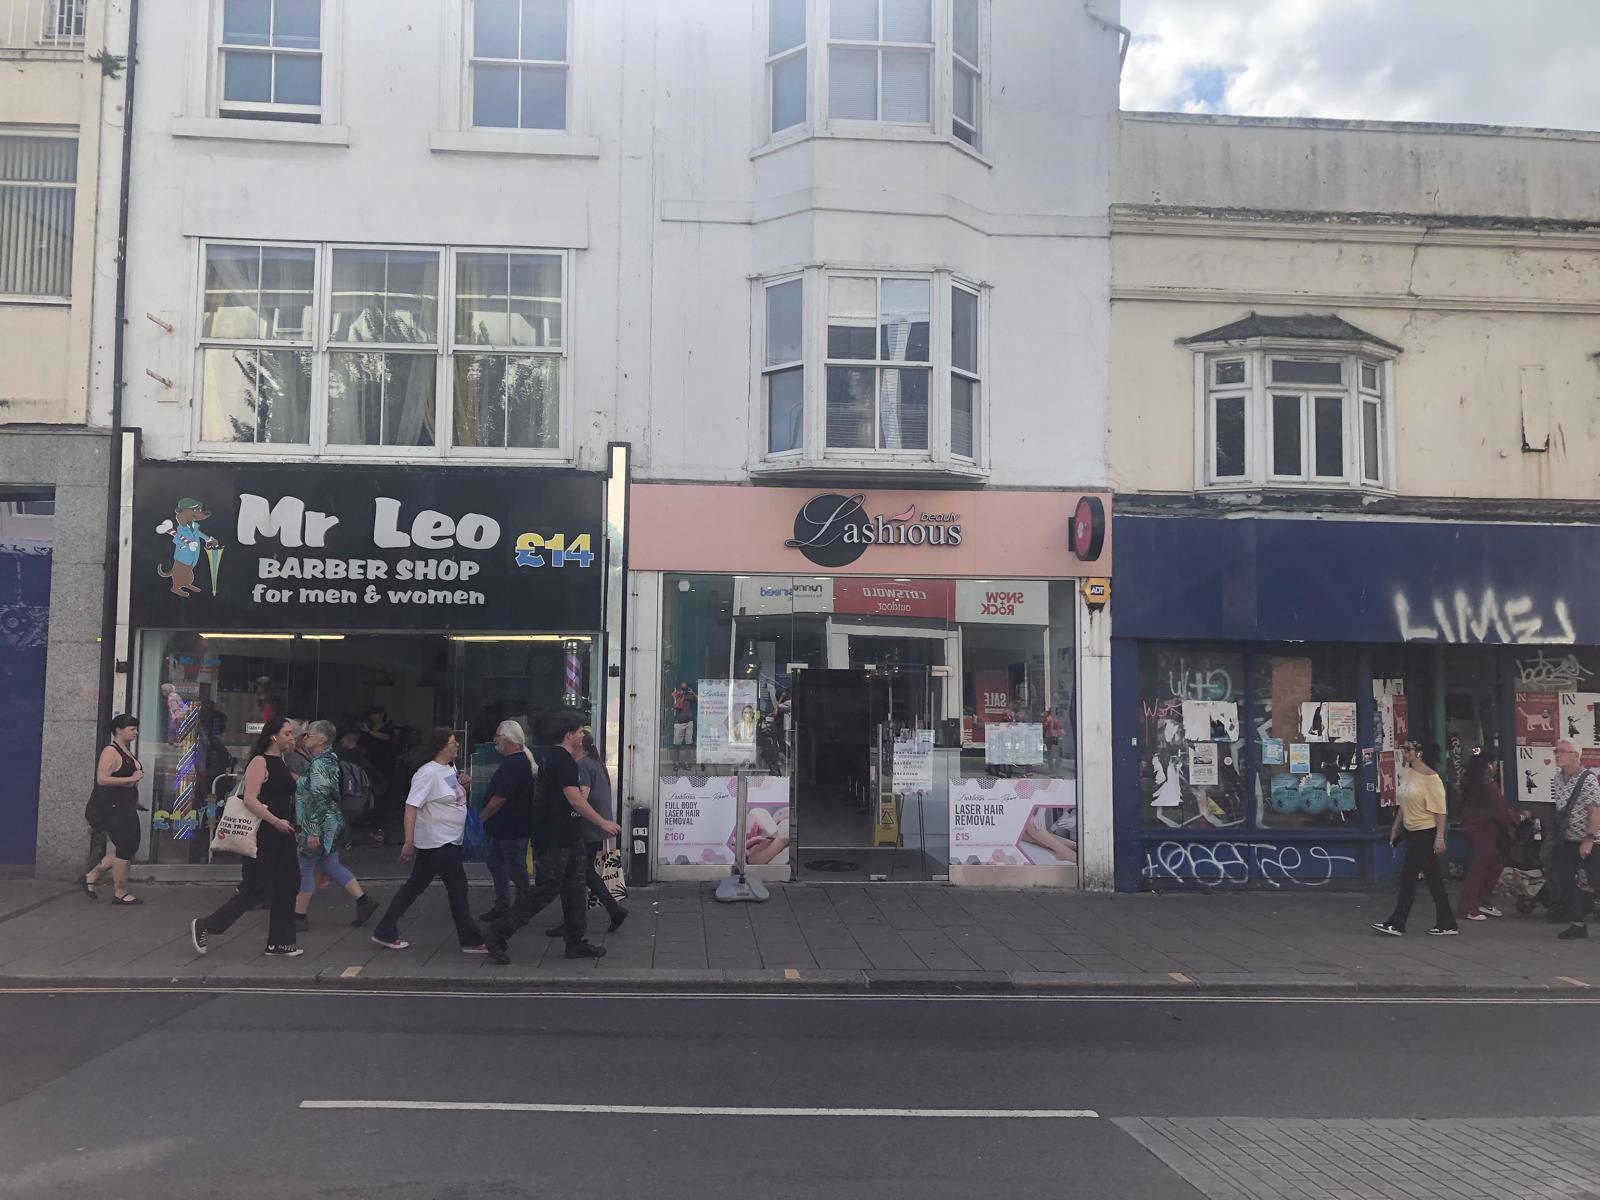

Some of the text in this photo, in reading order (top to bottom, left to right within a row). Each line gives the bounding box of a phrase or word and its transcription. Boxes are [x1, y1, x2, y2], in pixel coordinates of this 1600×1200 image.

[237, 493, 501, 550] Mr Leo
[785, 492, 963, 548] Lashious
[514, 532, 595, 569] £14
[258, 557, 481, 582] BARBER SHOP
[252, 583, 486, 606] for men & women
[1091, 586, 1104, 595] ADT
[955, 804, 1004, 815] LASER HAIR
[955, 815, 996, 826] REMOVAL
[664, 832, 685, 841] £160
[955, 832, 970, 841] £15
